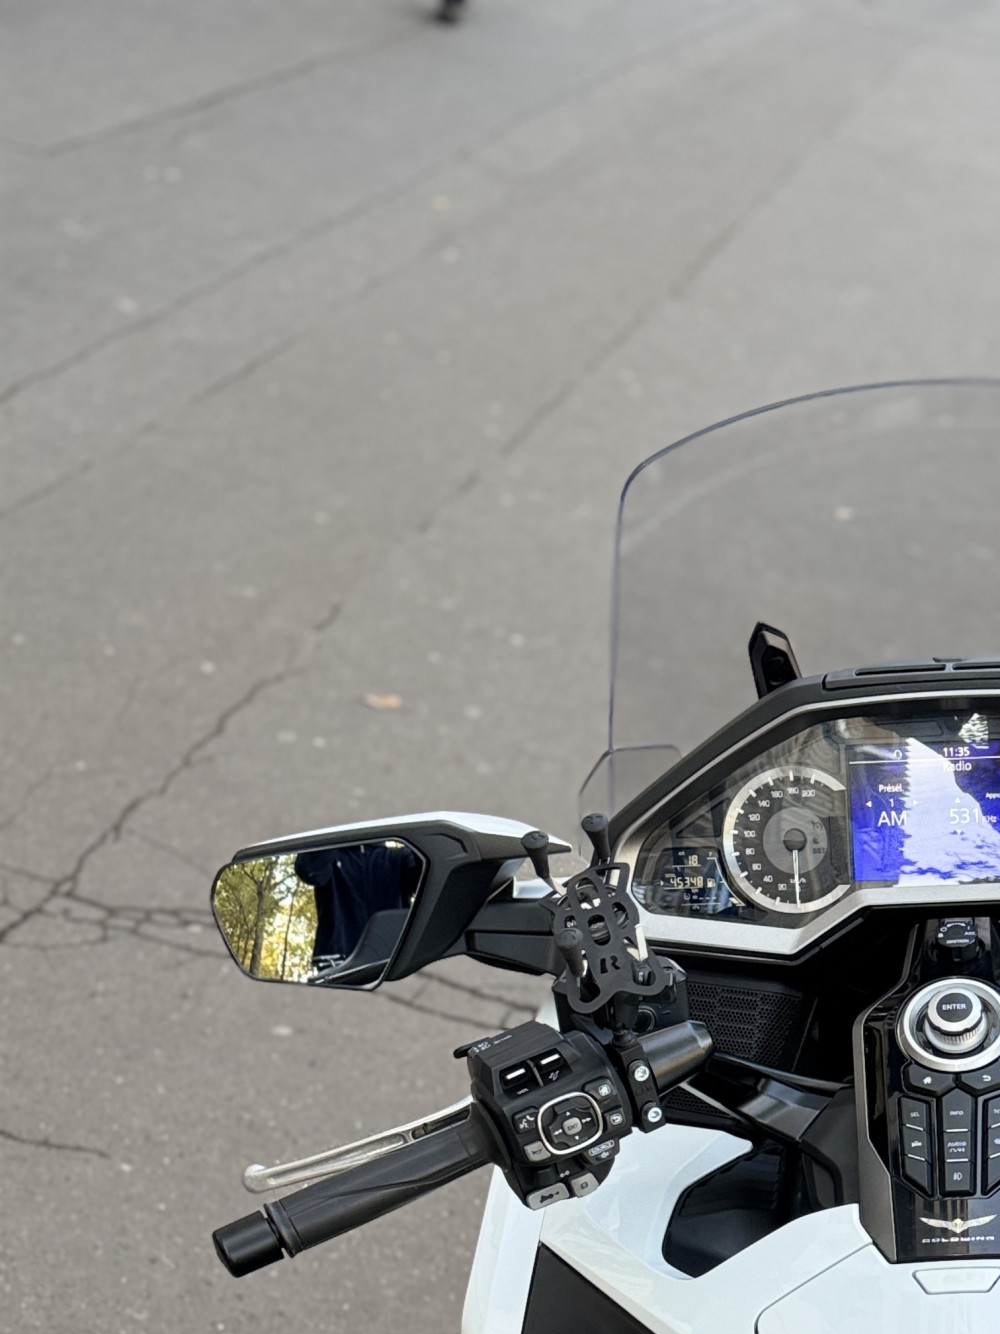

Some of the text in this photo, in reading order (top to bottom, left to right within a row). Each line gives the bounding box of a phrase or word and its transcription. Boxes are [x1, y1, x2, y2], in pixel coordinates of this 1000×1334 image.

[943, 747, 970, 757] 11:35
[943, 760, 972, 772] Radio
[748, 813, 760, 821] 120
[878, 811, 907, 827] AM
[949, 808, 979, 824] 531
[743, 830, 756, 838] 100
[670, 876, 703, 888] 45348
[942, 1003, 967, 1011] ENTER
